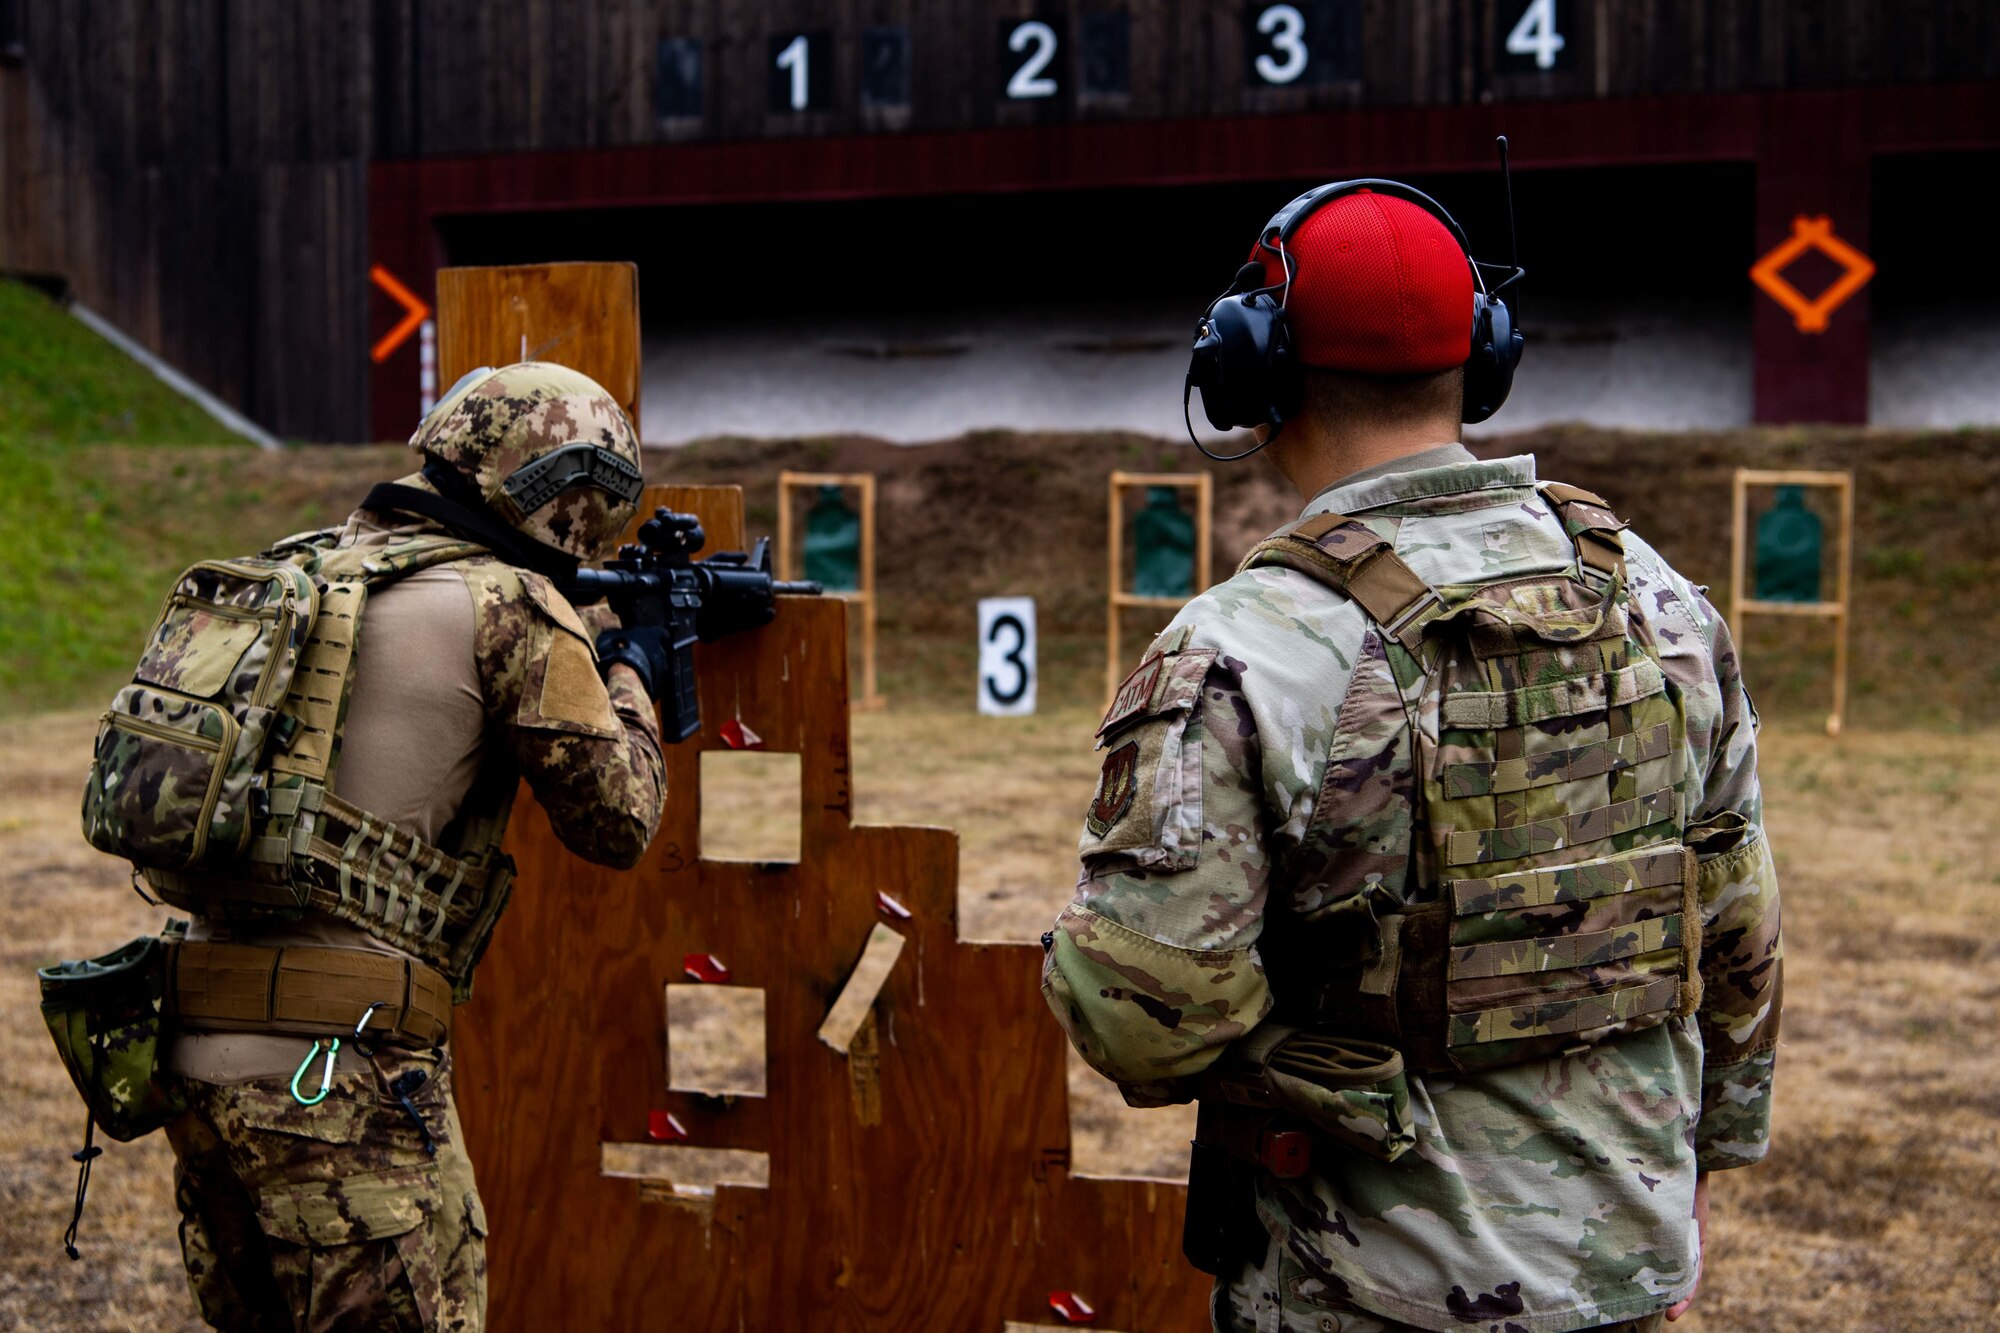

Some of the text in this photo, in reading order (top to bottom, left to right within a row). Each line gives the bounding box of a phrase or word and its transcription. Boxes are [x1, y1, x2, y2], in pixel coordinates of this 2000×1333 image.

[1006, 21, 1057, 97] 2
[1255, 4, 1309, 84] 3
[1506, 0, 1564, 68] 4
[777, 37, 808, 109] 1
[987, 614, 1028, 706] 3
[1106, 669, 1156, 722] CATM
